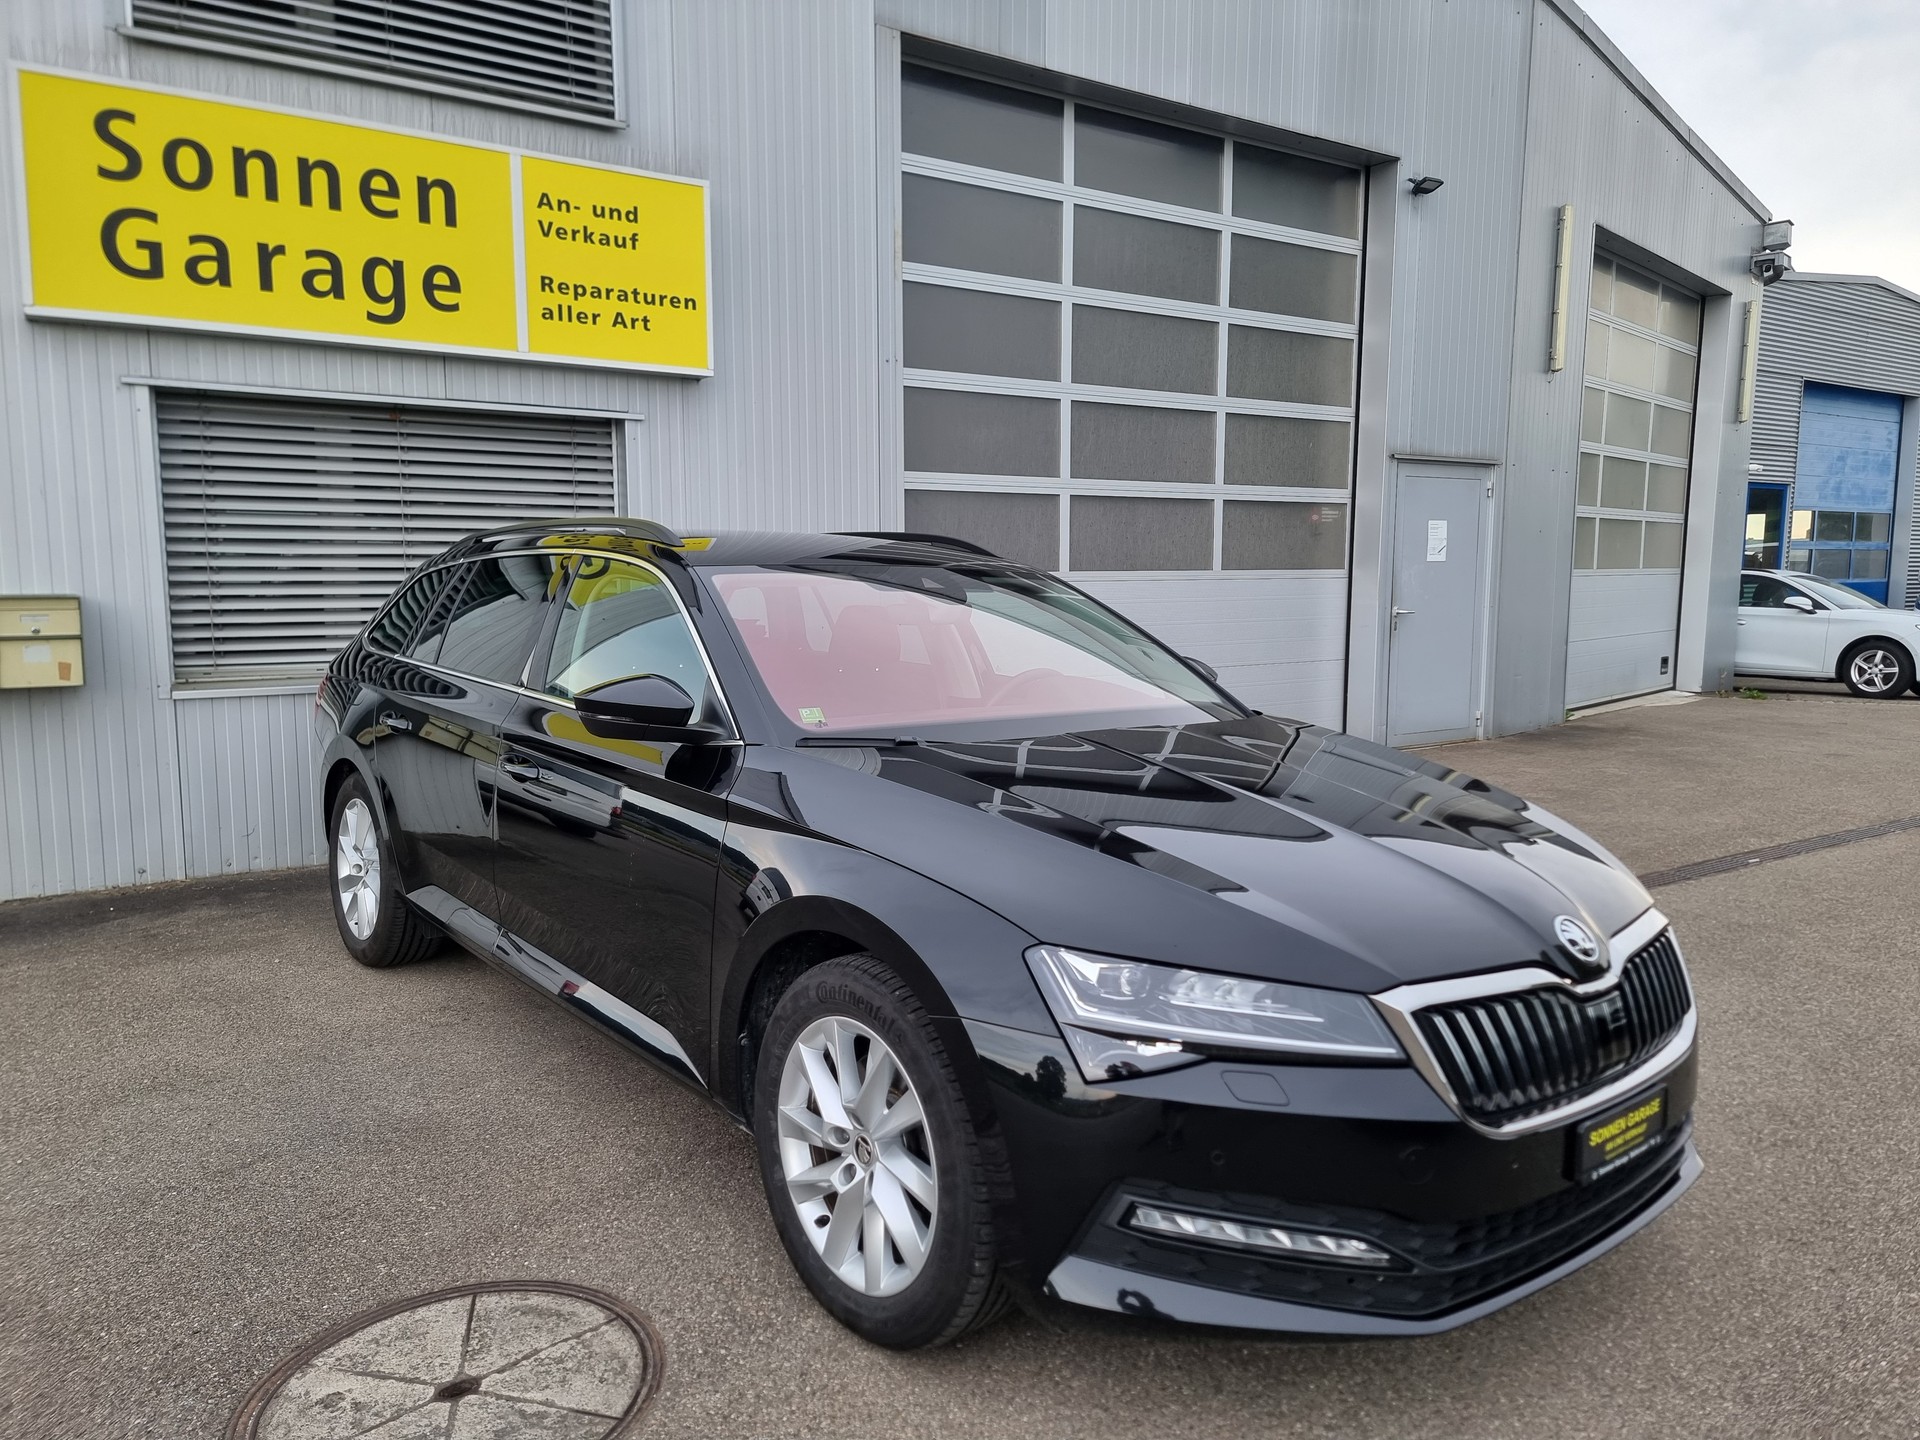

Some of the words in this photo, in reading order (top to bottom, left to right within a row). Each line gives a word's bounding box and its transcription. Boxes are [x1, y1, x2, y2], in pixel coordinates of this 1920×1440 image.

[93, 108, 457, 229] Sonnen
[536, 192, 581, 213] An-
[592, 204, 638, 223] und
[537, 219, 639, 250] Verkauf
[100, 207, 462, 325] Garage
[540, 275, 697, 311] Reparaturen
[541, 303, 601, 326] aller
[611, 311, 651, 331] Art
[816, 981, 896, 1034] Continental
